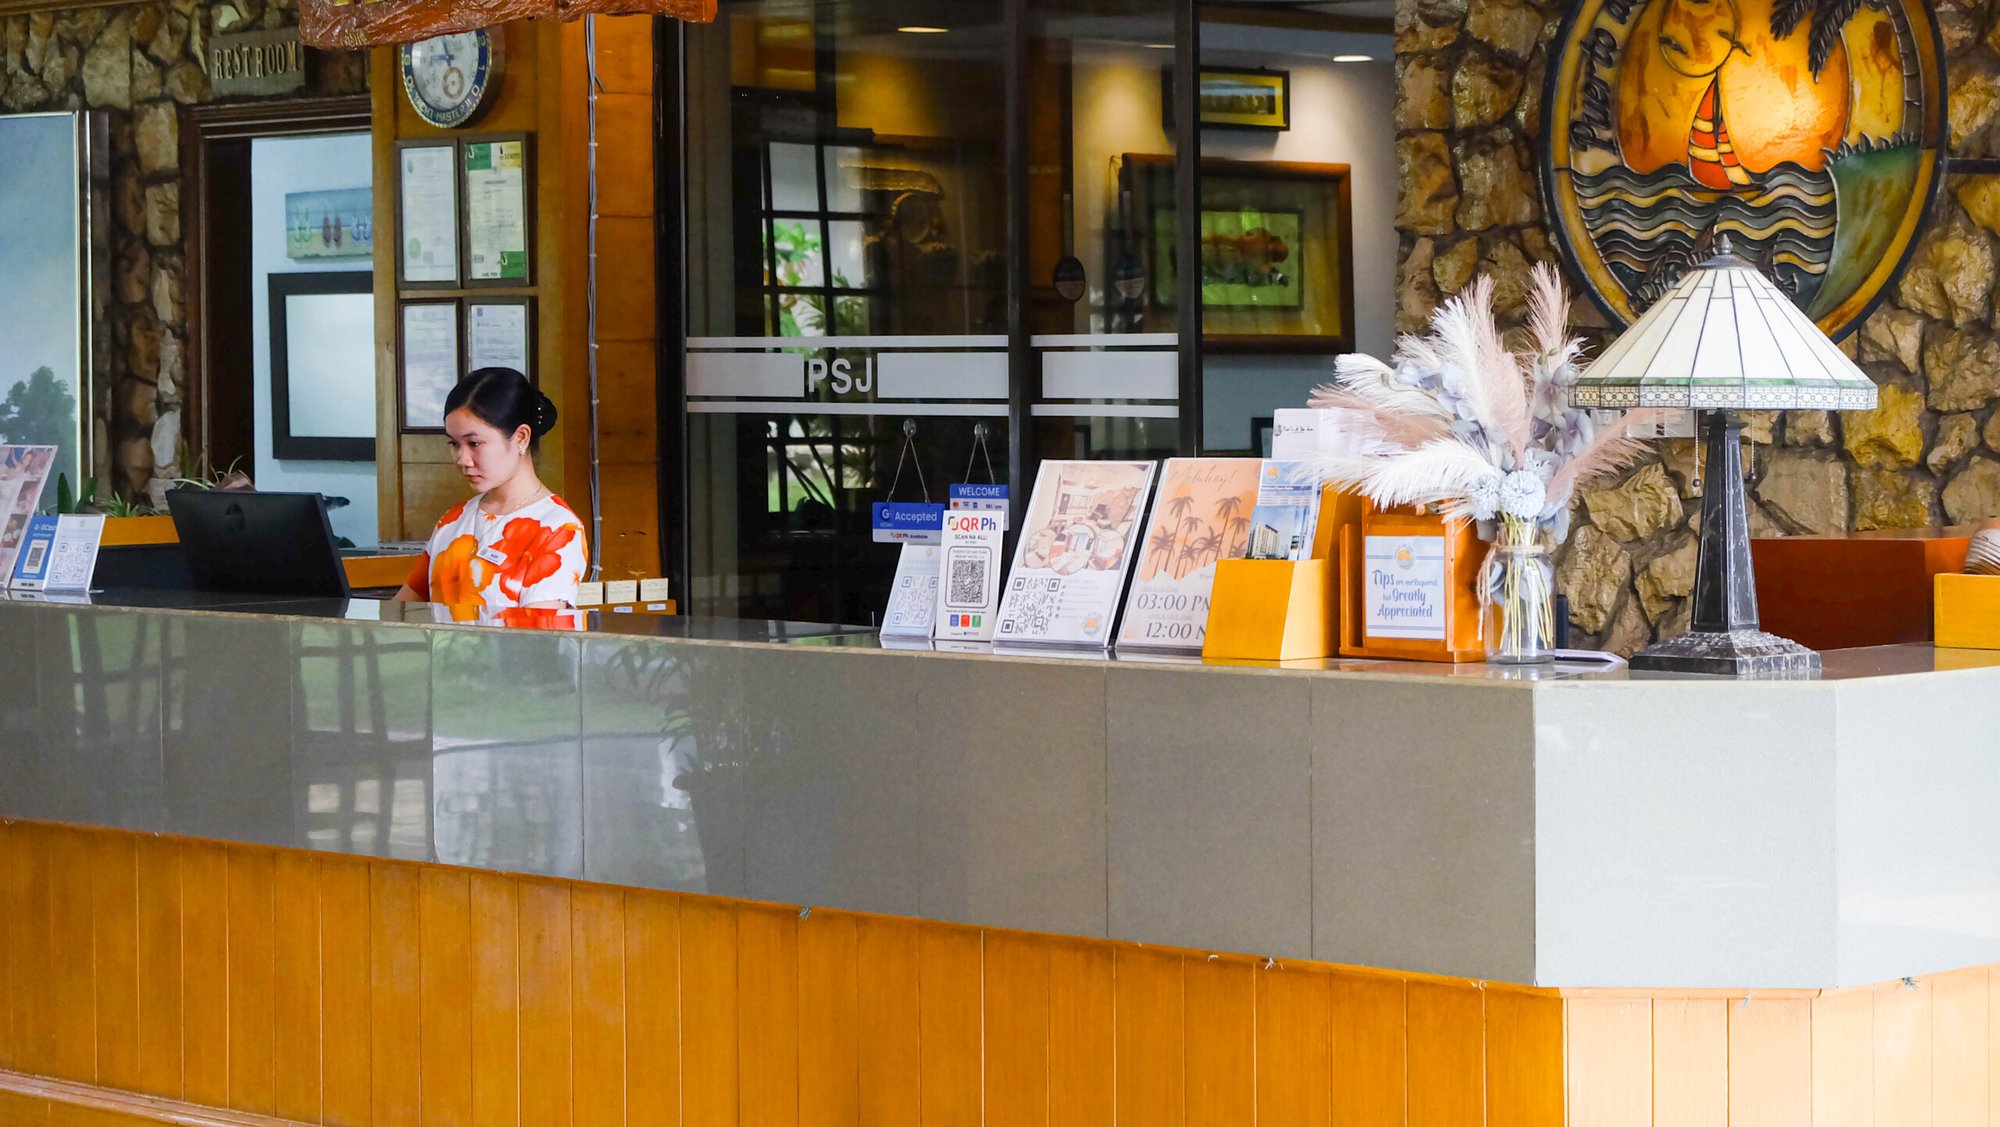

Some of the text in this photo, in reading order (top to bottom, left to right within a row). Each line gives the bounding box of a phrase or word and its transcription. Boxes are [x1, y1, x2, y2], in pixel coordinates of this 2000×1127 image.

[808, 357, 873, 395] PSJ
[958, 486, 1000, 497] WELCOME
[895, 511, 938, 524] Accepted
[959, 517, 997, 532] QR Ph
[1372, 569, 1394, 589] Tips
[1137, 593, 1187, 611] 03:00
[1392, 588, 1426, 606] Greatly
[1377, 603, 1433, 620] Appreciated
[1146, 621, 1192, 640] 12:00
